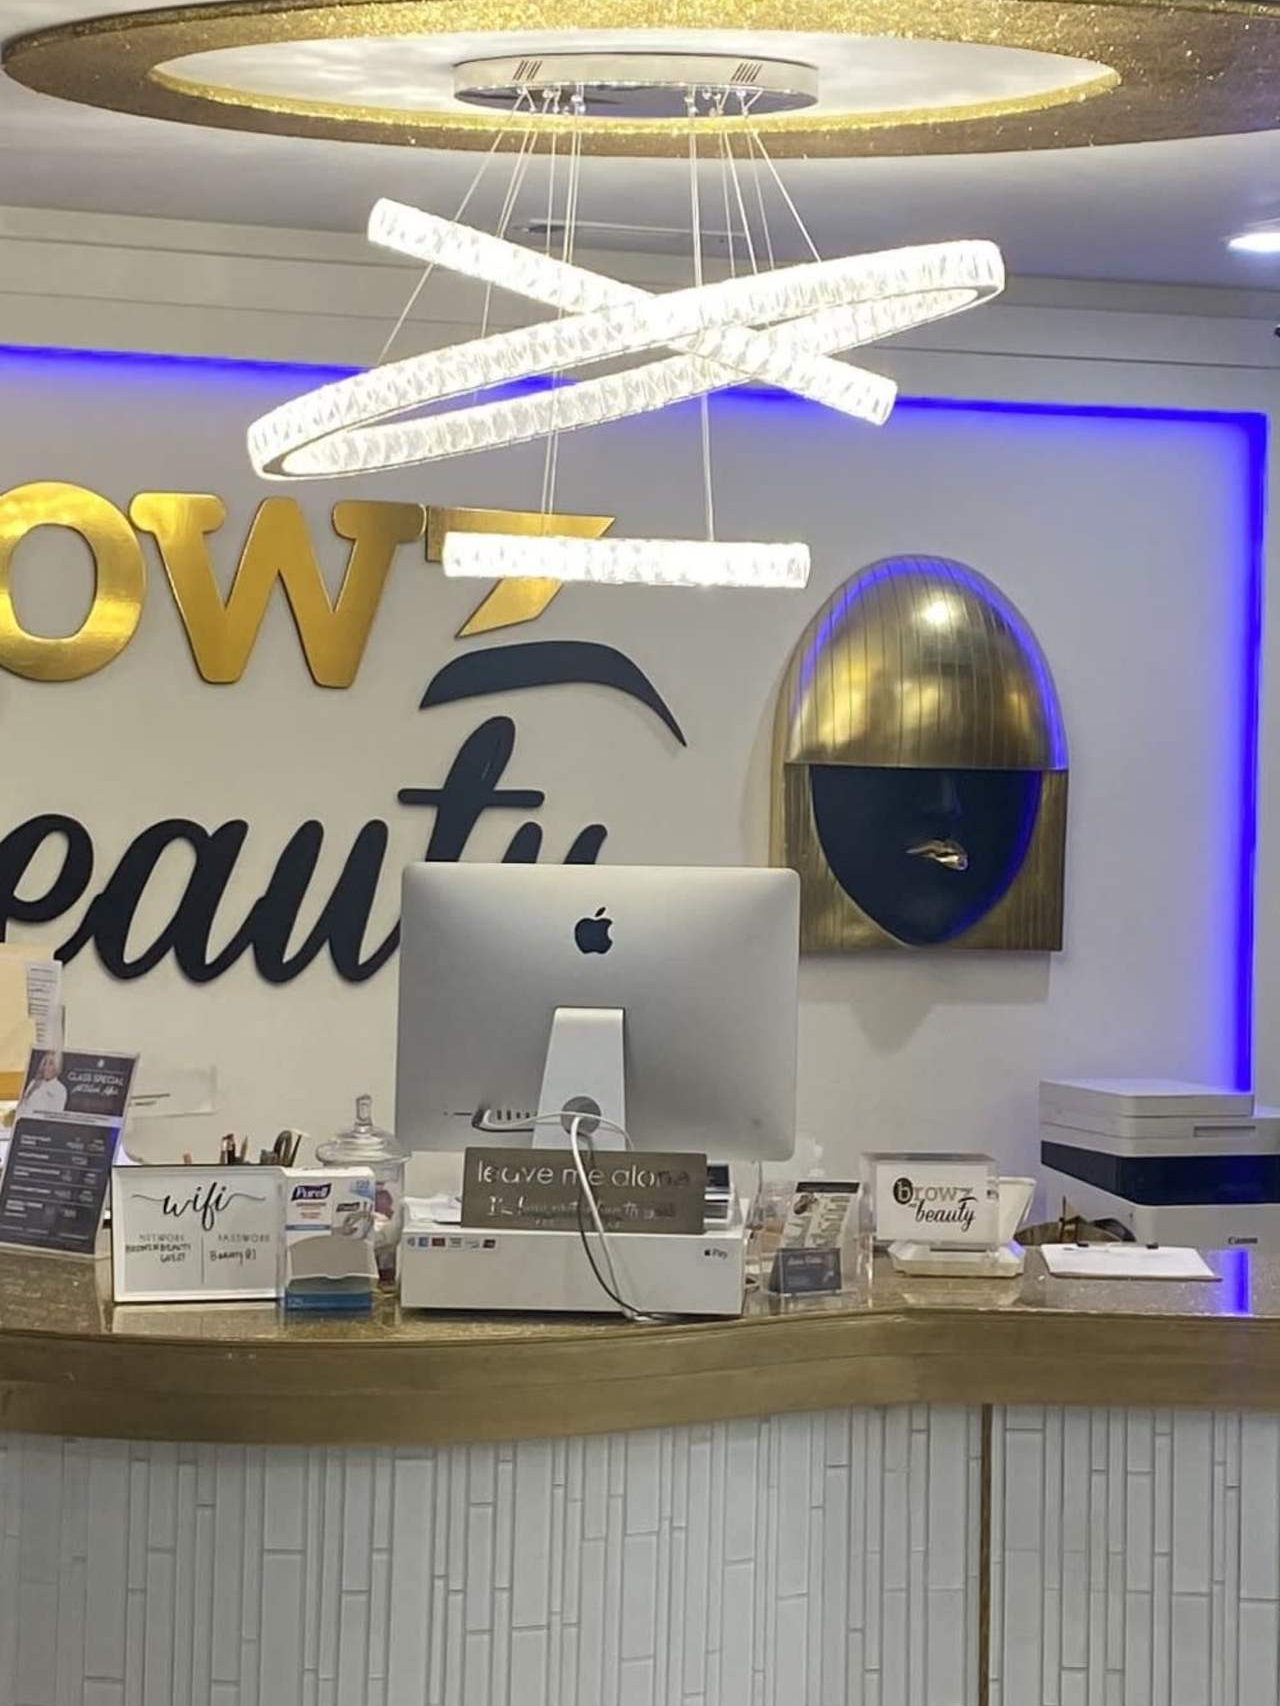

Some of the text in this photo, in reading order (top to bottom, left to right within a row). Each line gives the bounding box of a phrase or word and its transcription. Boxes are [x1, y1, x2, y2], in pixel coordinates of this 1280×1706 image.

[477, 1160, 554, 1185] leave
[562, 1167, 605, 1186] me
[896, 1179, 974, 1203] browz
[915, 1199, 975, 1233] beauty
